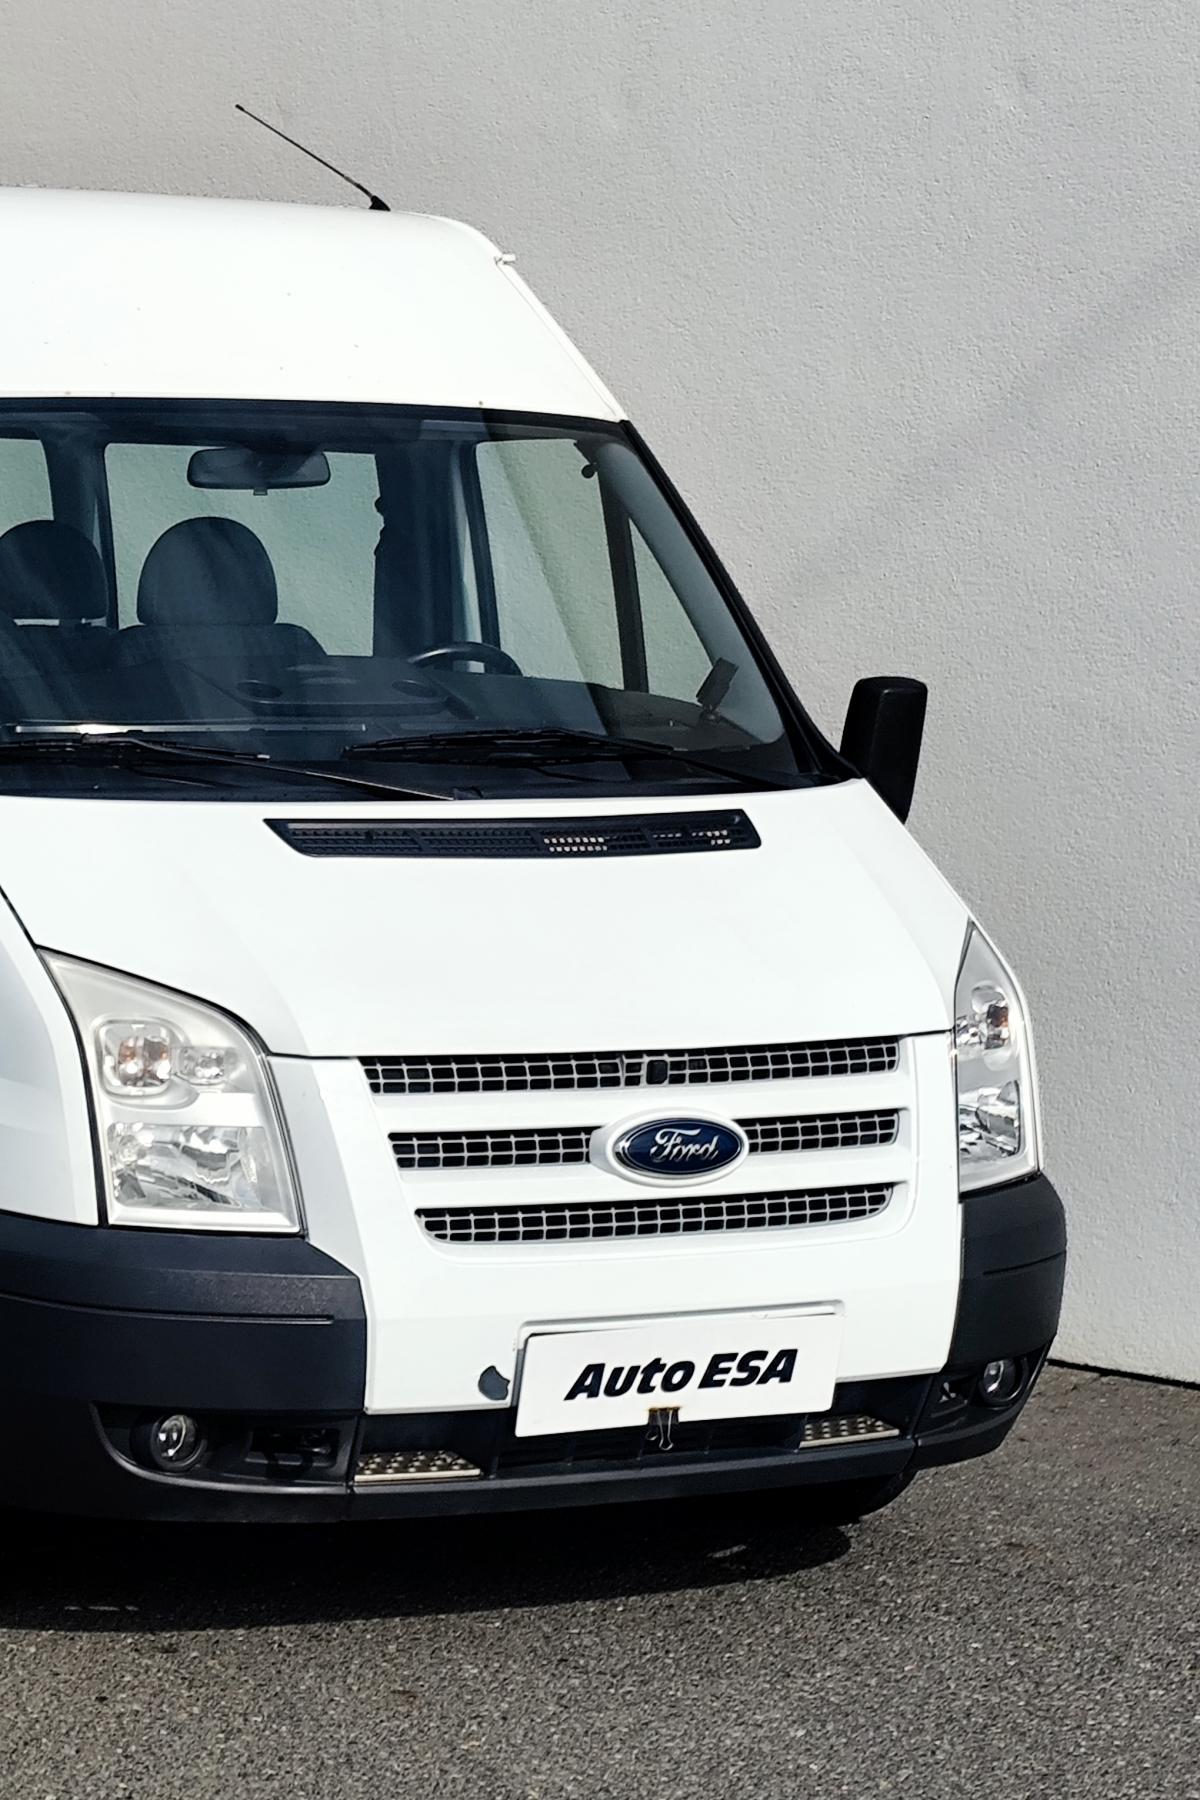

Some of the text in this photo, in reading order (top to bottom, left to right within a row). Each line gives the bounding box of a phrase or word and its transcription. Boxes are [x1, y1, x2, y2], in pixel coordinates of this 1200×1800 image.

[650, 1128, 719, 1162] Ford
[563, 1348, 798, 1401] Auto ESA
